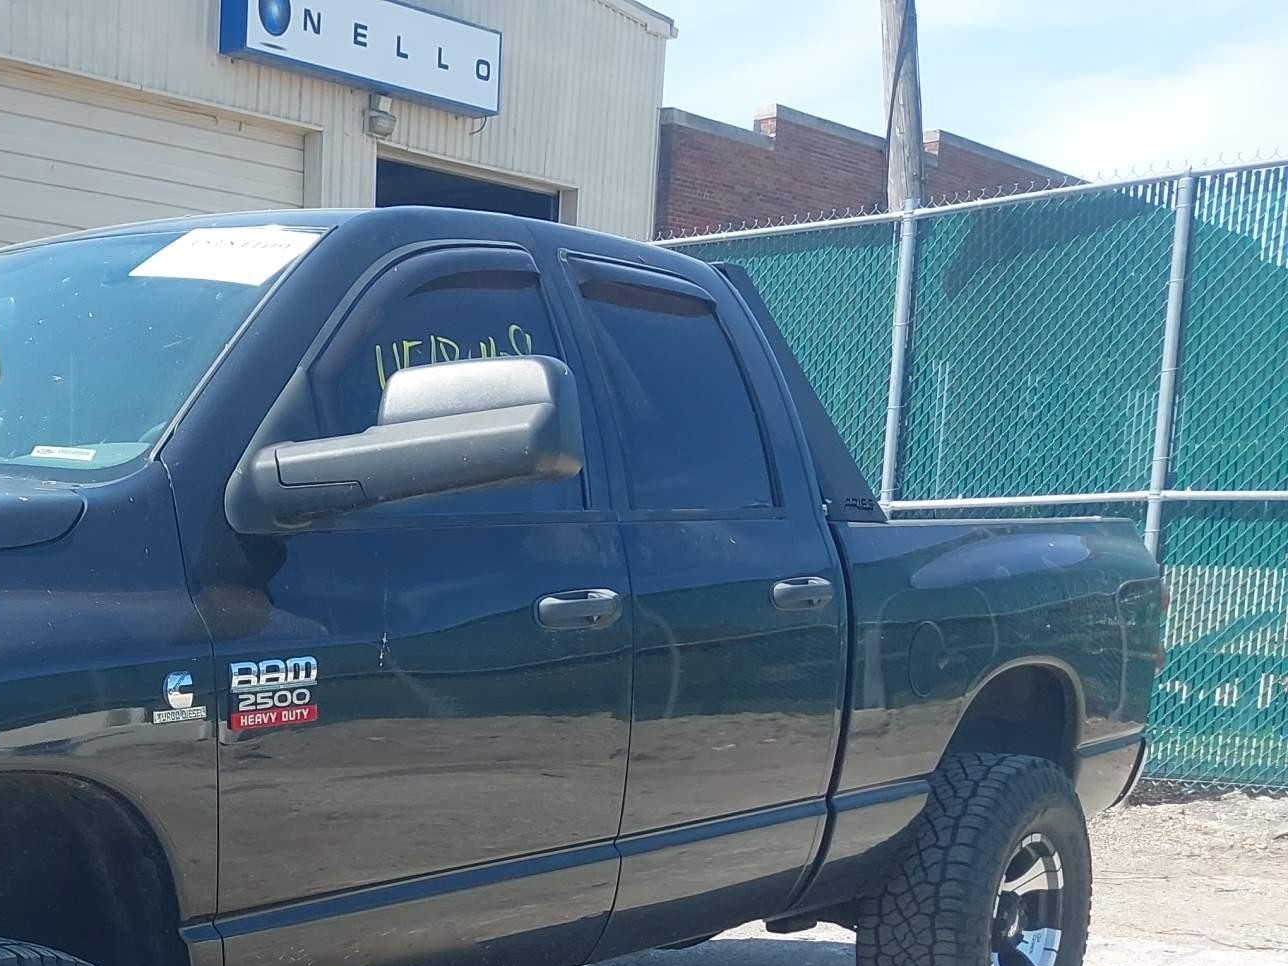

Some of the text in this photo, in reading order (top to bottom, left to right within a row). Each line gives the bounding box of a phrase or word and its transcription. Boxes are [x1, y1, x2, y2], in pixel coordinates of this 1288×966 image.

[843, 497, 874, 511] ARIES
[230, 655, 318, 690] RAM
[238, 689, 311, 712] 2500
[240, 708, 310, 726] HEAVY DUTY
